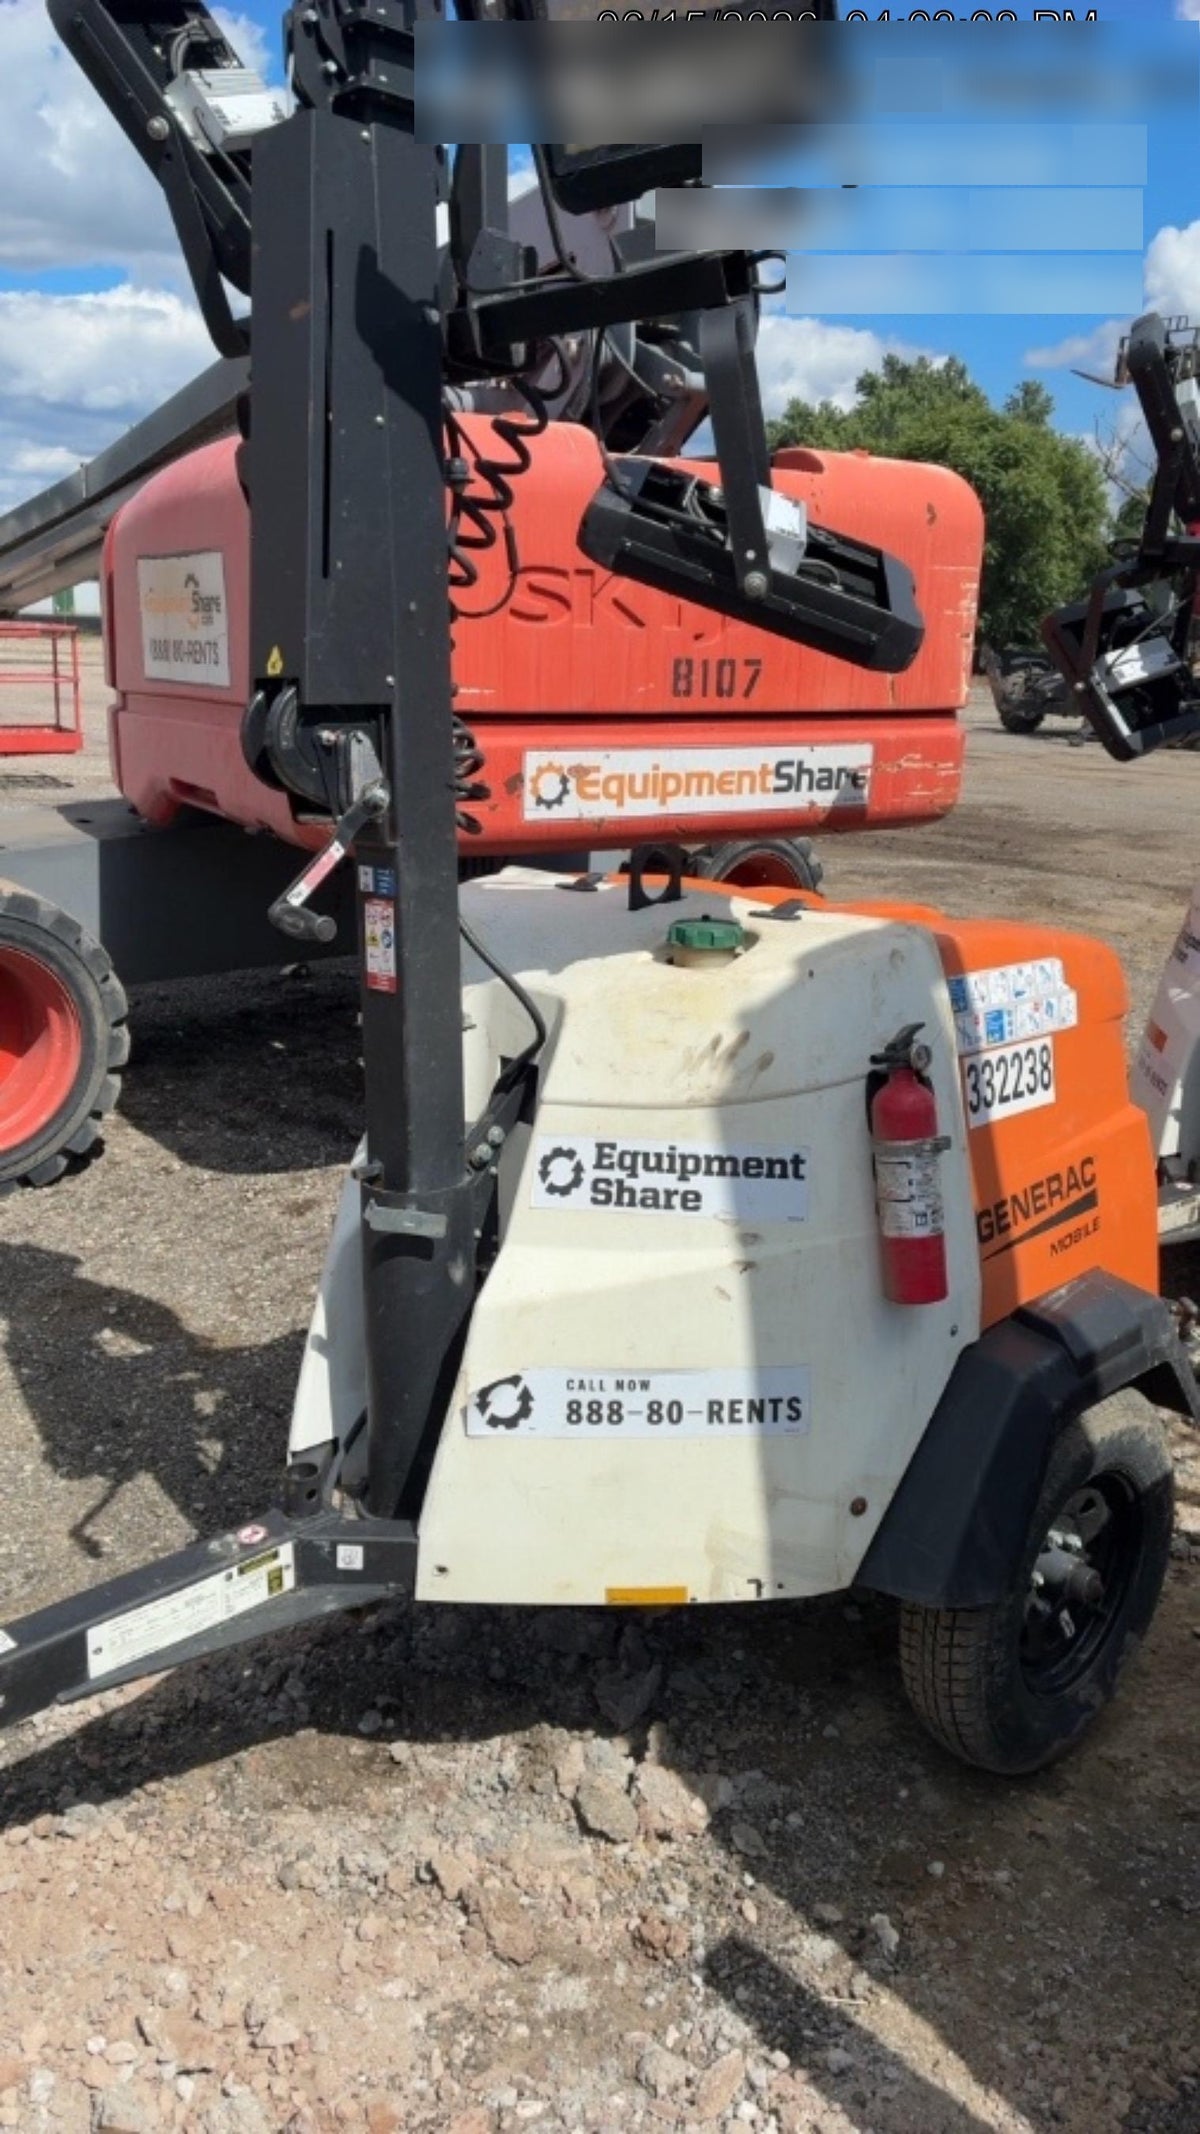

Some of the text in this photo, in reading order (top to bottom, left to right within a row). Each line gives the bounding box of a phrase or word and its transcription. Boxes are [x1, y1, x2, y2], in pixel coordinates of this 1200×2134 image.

[574, 760, 867, 806] EquipmentShare
[967, 1045, 1052, 1114] 332238
[592, 1142, 806, 1181] Equipment
[590, 1178, 702, 1211] Share
[976, 1157, 1097, 1243] GENERAC
[1050, 1217, 1101, 1256] MOBILE
[566, 1379, 651, 1391] CALL NOW
[566, 1397, 802, 1426] 888-80-RENTS
